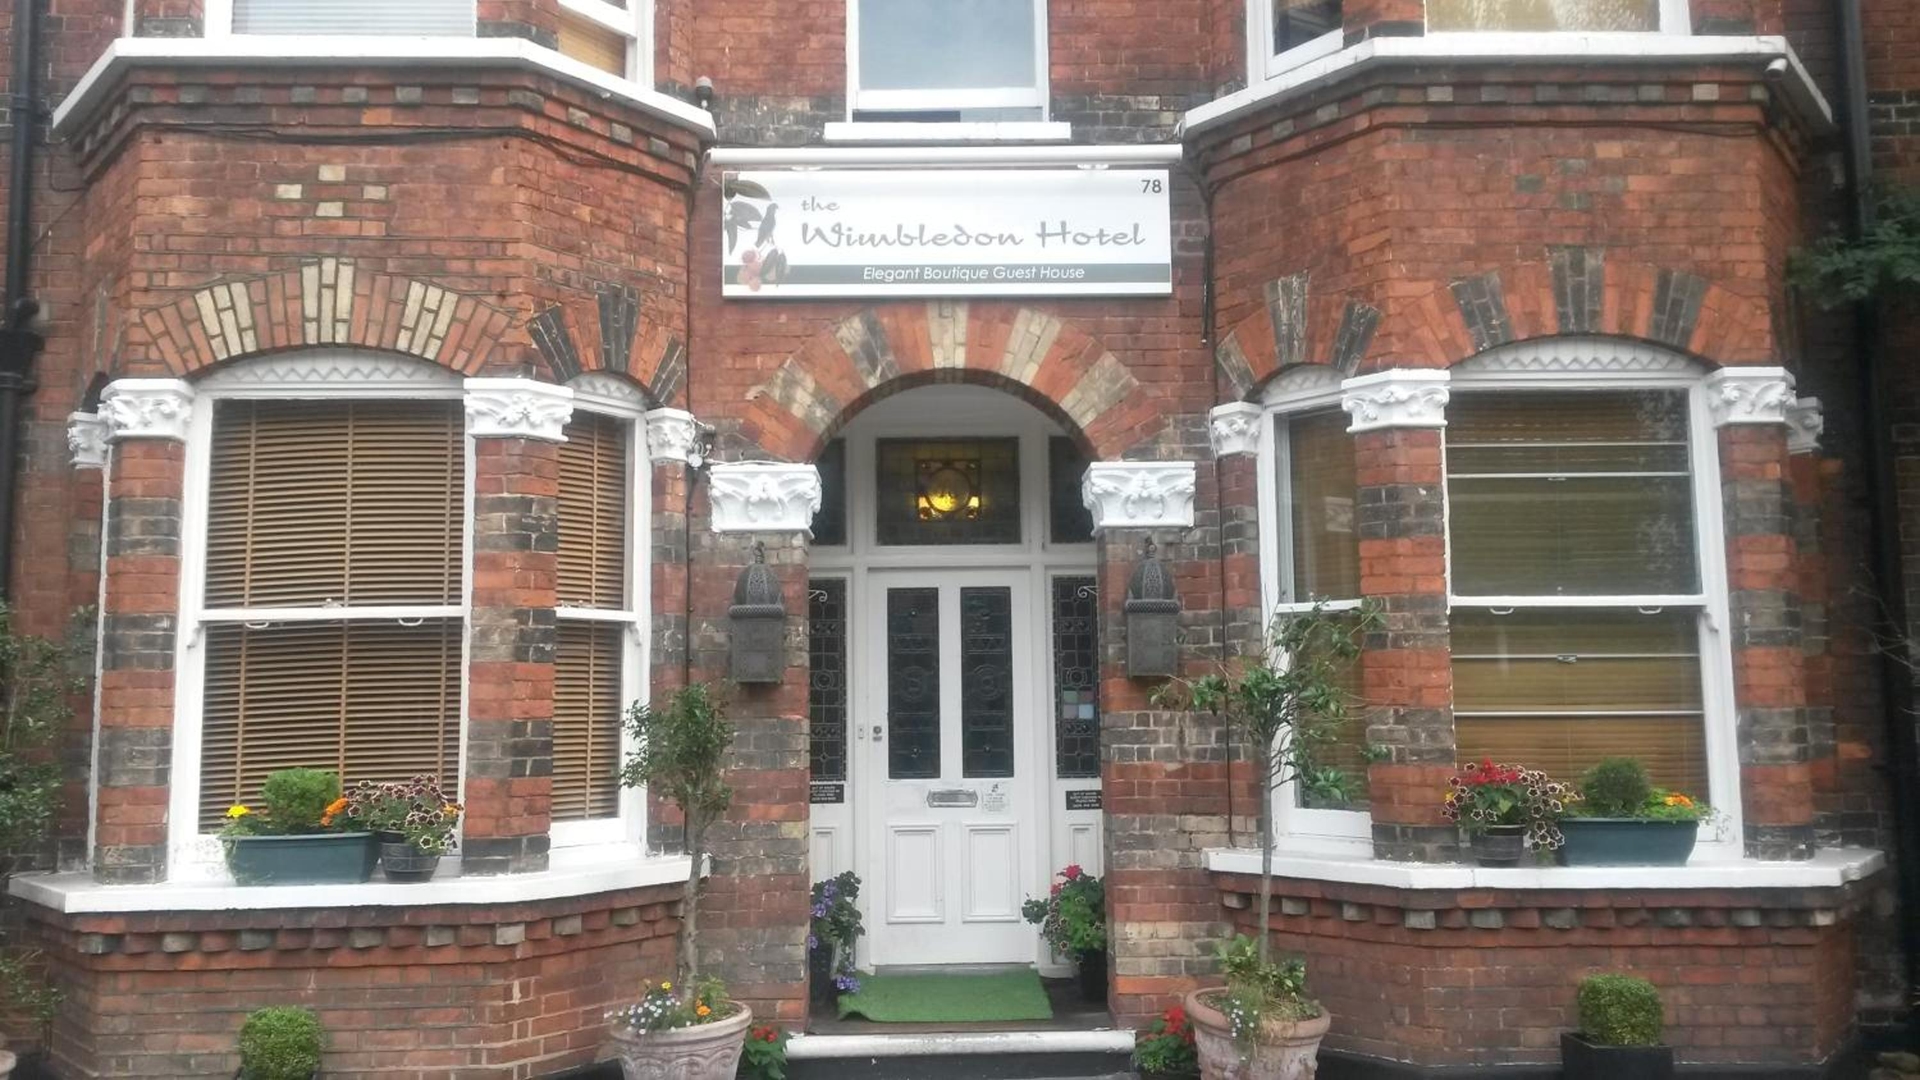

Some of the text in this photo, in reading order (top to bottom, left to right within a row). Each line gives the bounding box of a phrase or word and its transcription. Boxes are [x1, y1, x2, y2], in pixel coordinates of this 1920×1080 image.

[1140, 179, 1162, 194] 78
[801, 195, 841, 212] the
[801, 220, 1146, 248] Wimbledon Hotel
[863, 265, 1086, 283] Elegant Boutique Guest House
